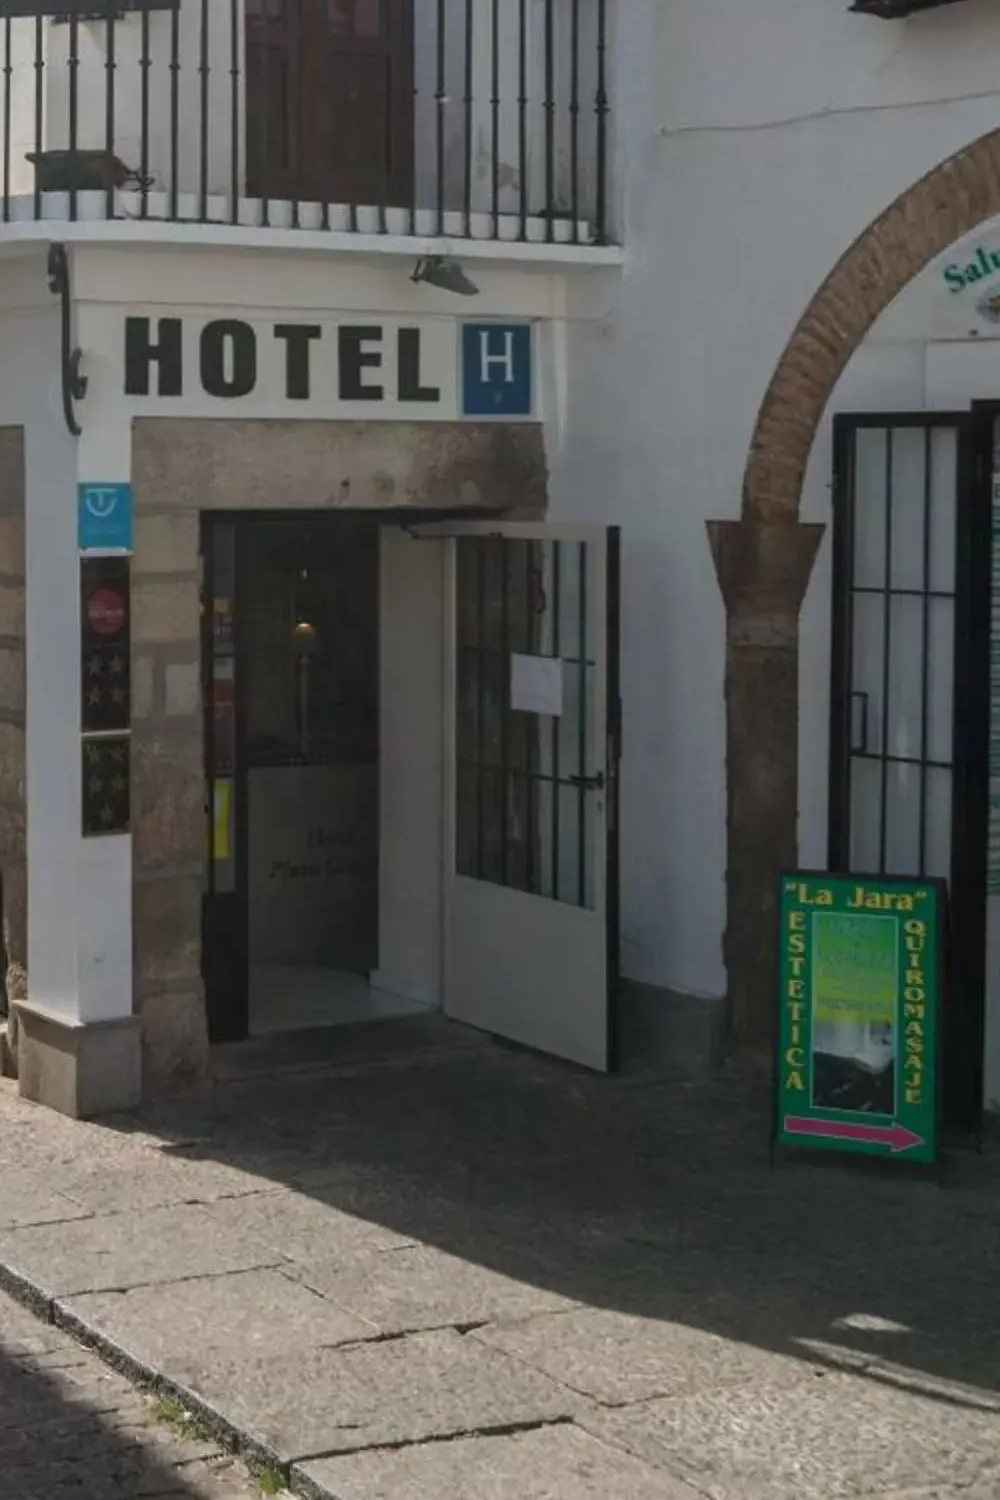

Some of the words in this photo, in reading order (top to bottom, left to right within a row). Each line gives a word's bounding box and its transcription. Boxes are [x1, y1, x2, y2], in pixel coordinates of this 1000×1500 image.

[124, 316, 441, 403] HOTEL
[479, 330, 514, 383] H
[785, 911, 806, 1091] ESTETICA
[904, 918, 927, 1105] QUIROMASAJE
